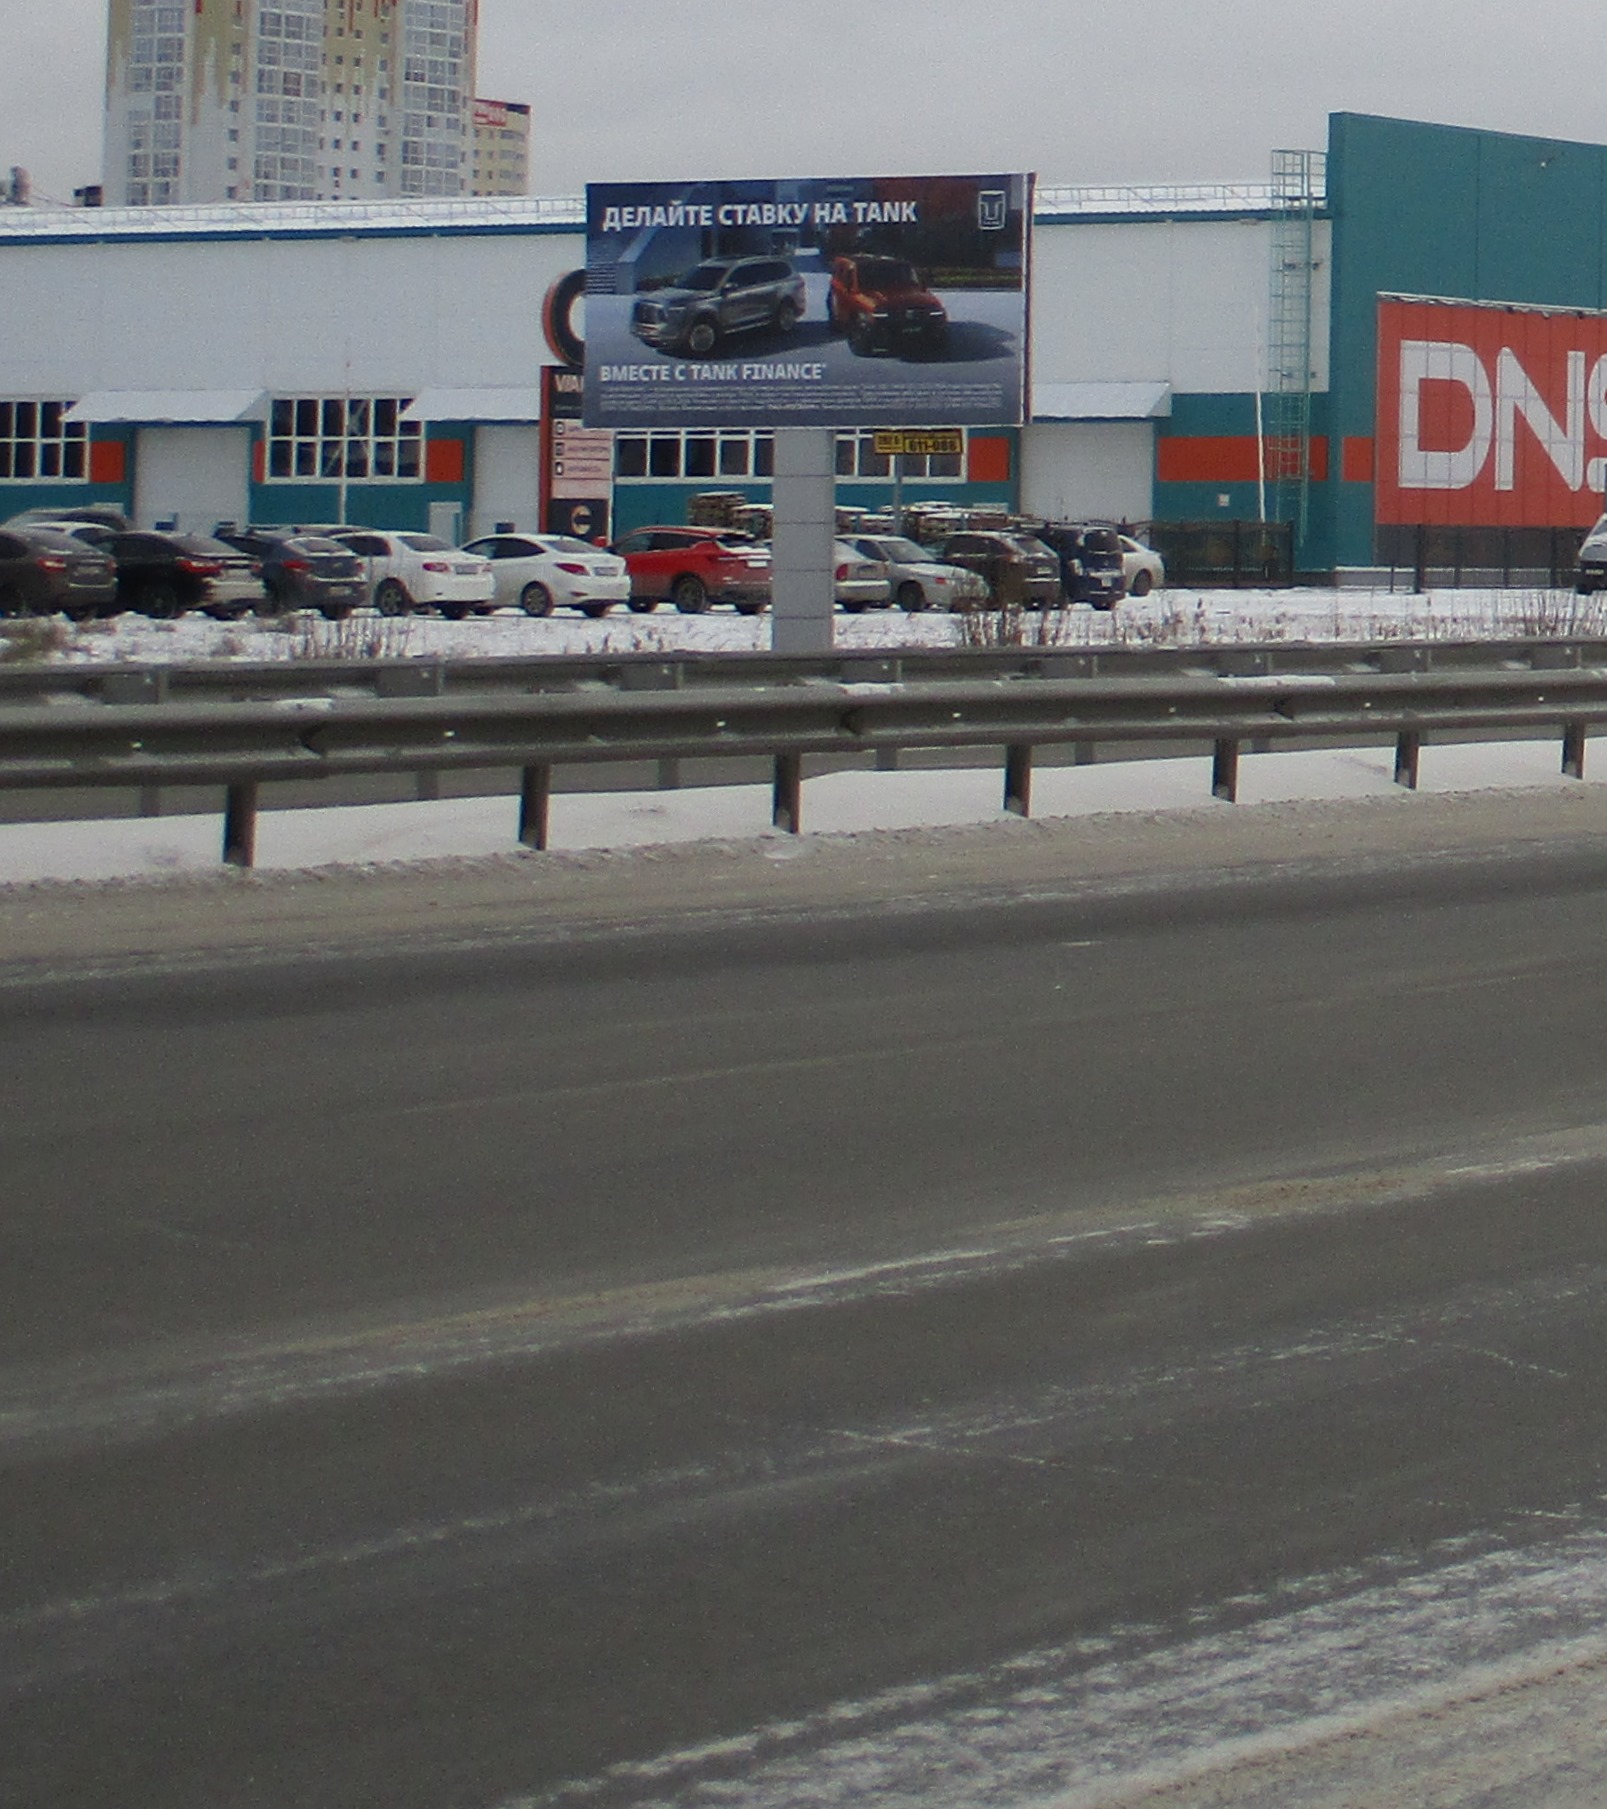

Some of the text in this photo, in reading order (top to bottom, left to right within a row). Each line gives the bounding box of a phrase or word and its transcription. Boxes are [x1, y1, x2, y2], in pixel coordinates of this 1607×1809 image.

[602, 199, 918, 233] ДЕЛАЙТЕ СТАВКУ НА TANK
[601, 365, 671, 382] ВМЕСТЕ
[675, 365, 687, 381] С
[691, 364, 738, 381] TANK
